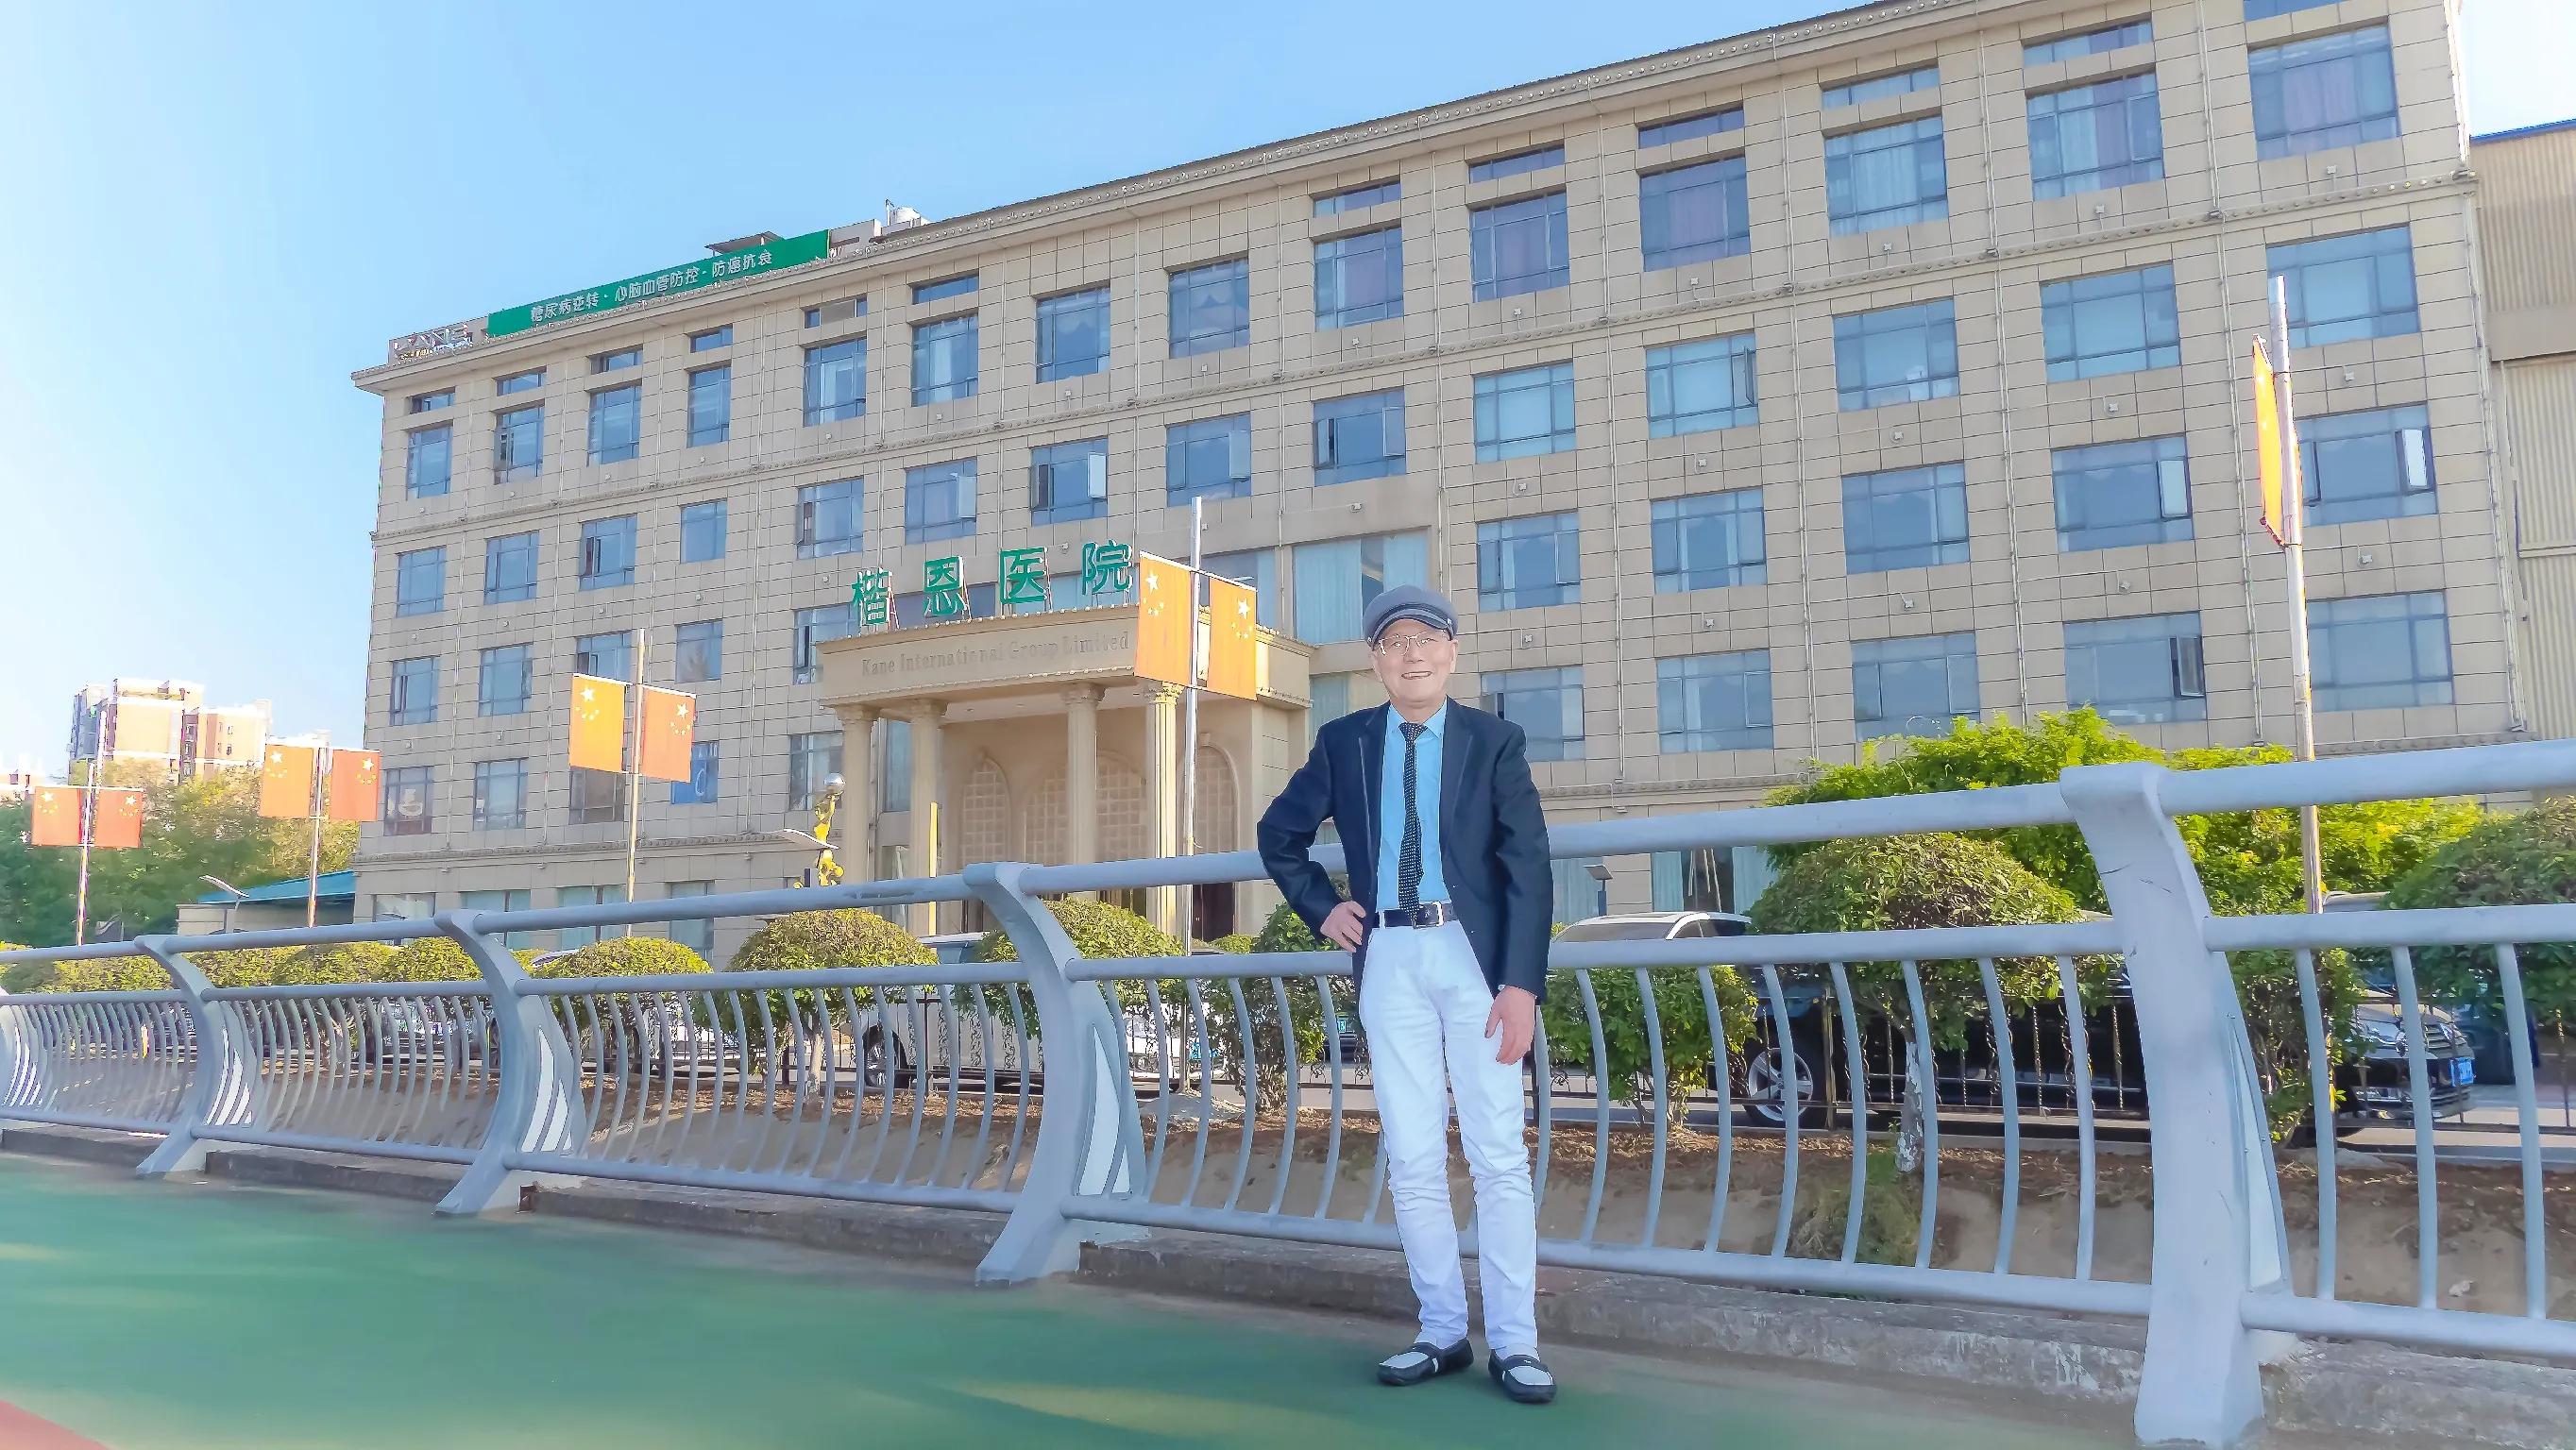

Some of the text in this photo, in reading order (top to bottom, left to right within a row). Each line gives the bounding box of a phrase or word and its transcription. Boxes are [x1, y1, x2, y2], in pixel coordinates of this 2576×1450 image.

[852, 539, 1132, 625] 楷恩医院
[861, 658, 895, 676] Kane
[900, 646, 1003, 672] International
[1062, 631, 1130, 655] Limited
